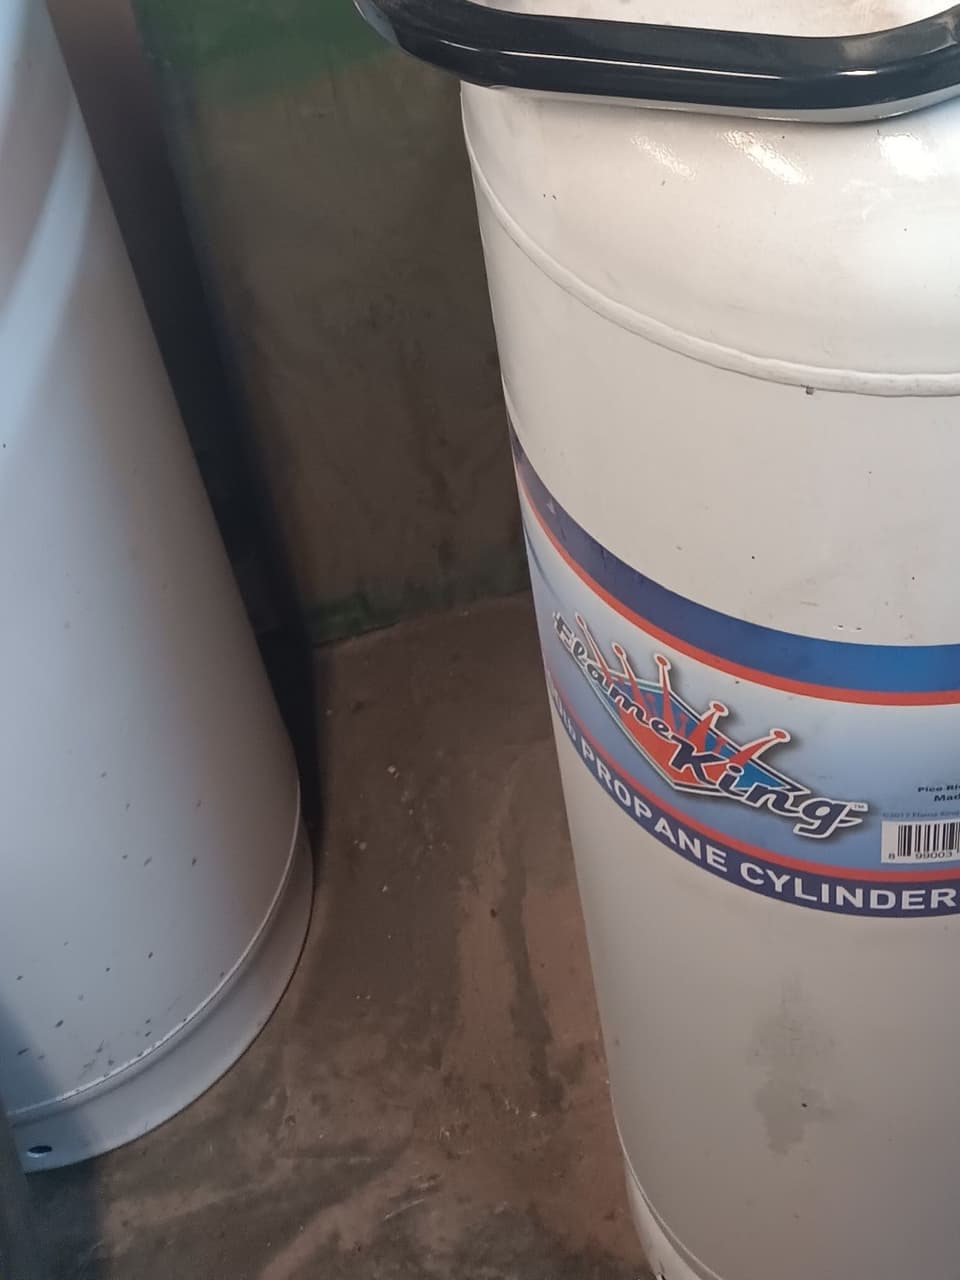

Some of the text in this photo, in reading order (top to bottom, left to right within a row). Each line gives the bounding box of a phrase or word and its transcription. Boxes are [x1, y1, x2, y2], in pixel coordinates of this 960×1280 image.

[552, 611, 674, 740] Flame
[667, 734, 860, 837] King
[581, 740, 727, 873] PROPANE
[740, 862, 957, 910] CYLINDER
[888, 852, 896, 860] 8
[915, 850, 953, 860] 99003
